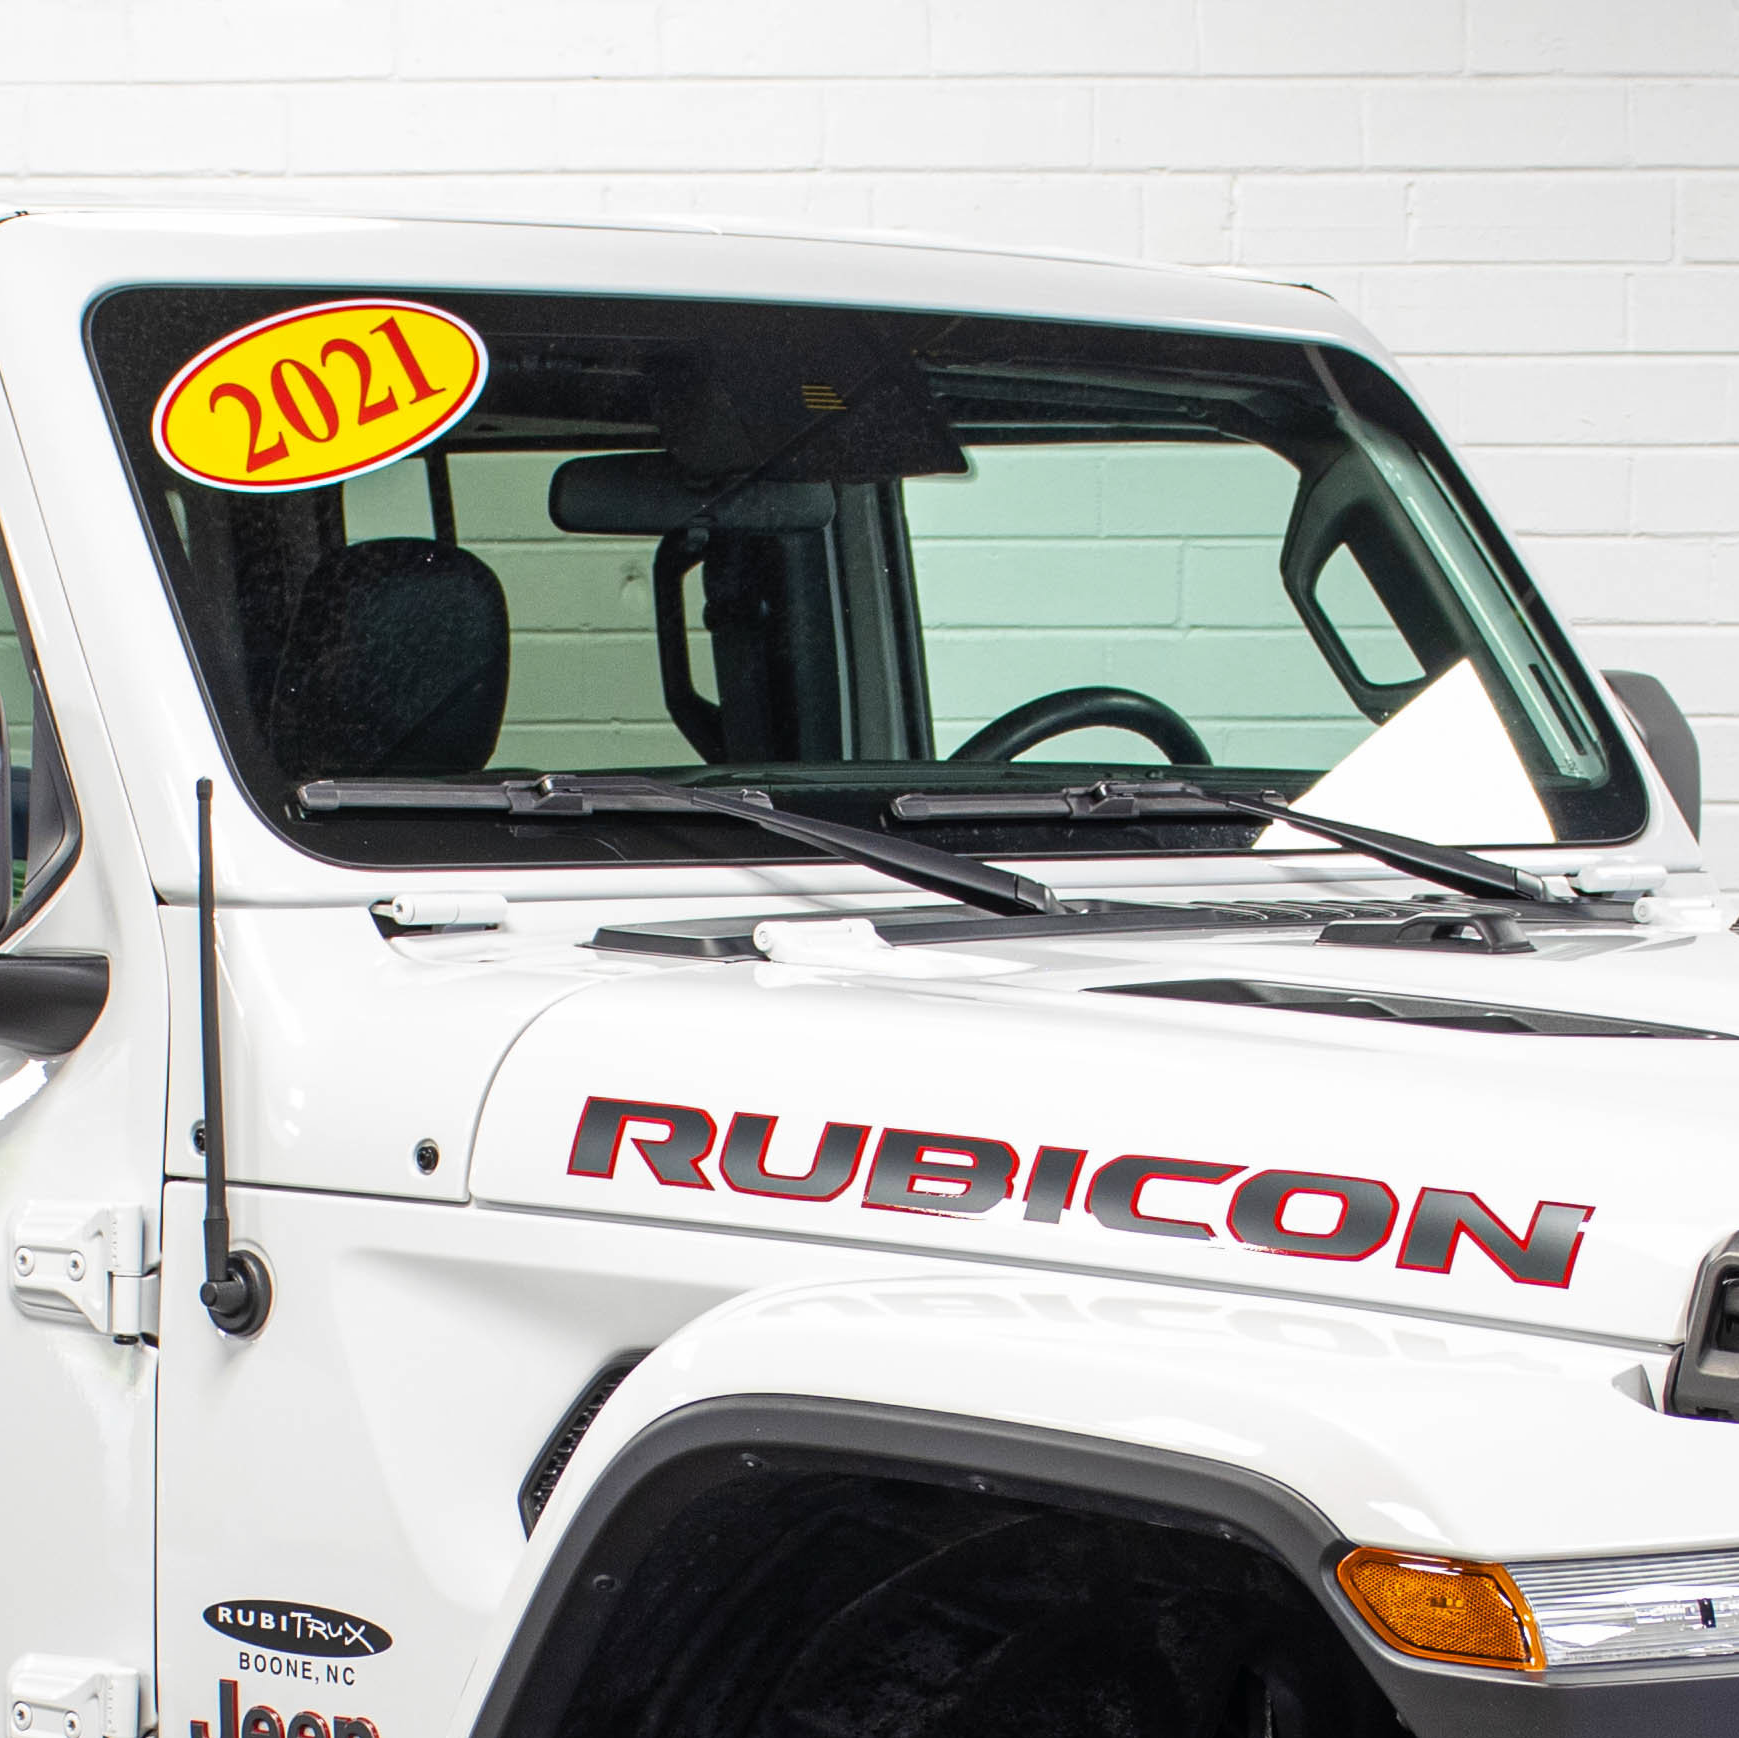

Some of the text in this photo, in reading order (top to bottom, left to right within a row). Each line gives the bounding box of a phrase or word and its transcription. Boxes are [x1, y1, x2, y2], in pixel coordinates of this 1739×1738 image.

[209, 315, 447, 473] 2021
[567, 1096, 1597, 1290] RUBICON
[238, 1651, 356, 1686] BOONE, NC
